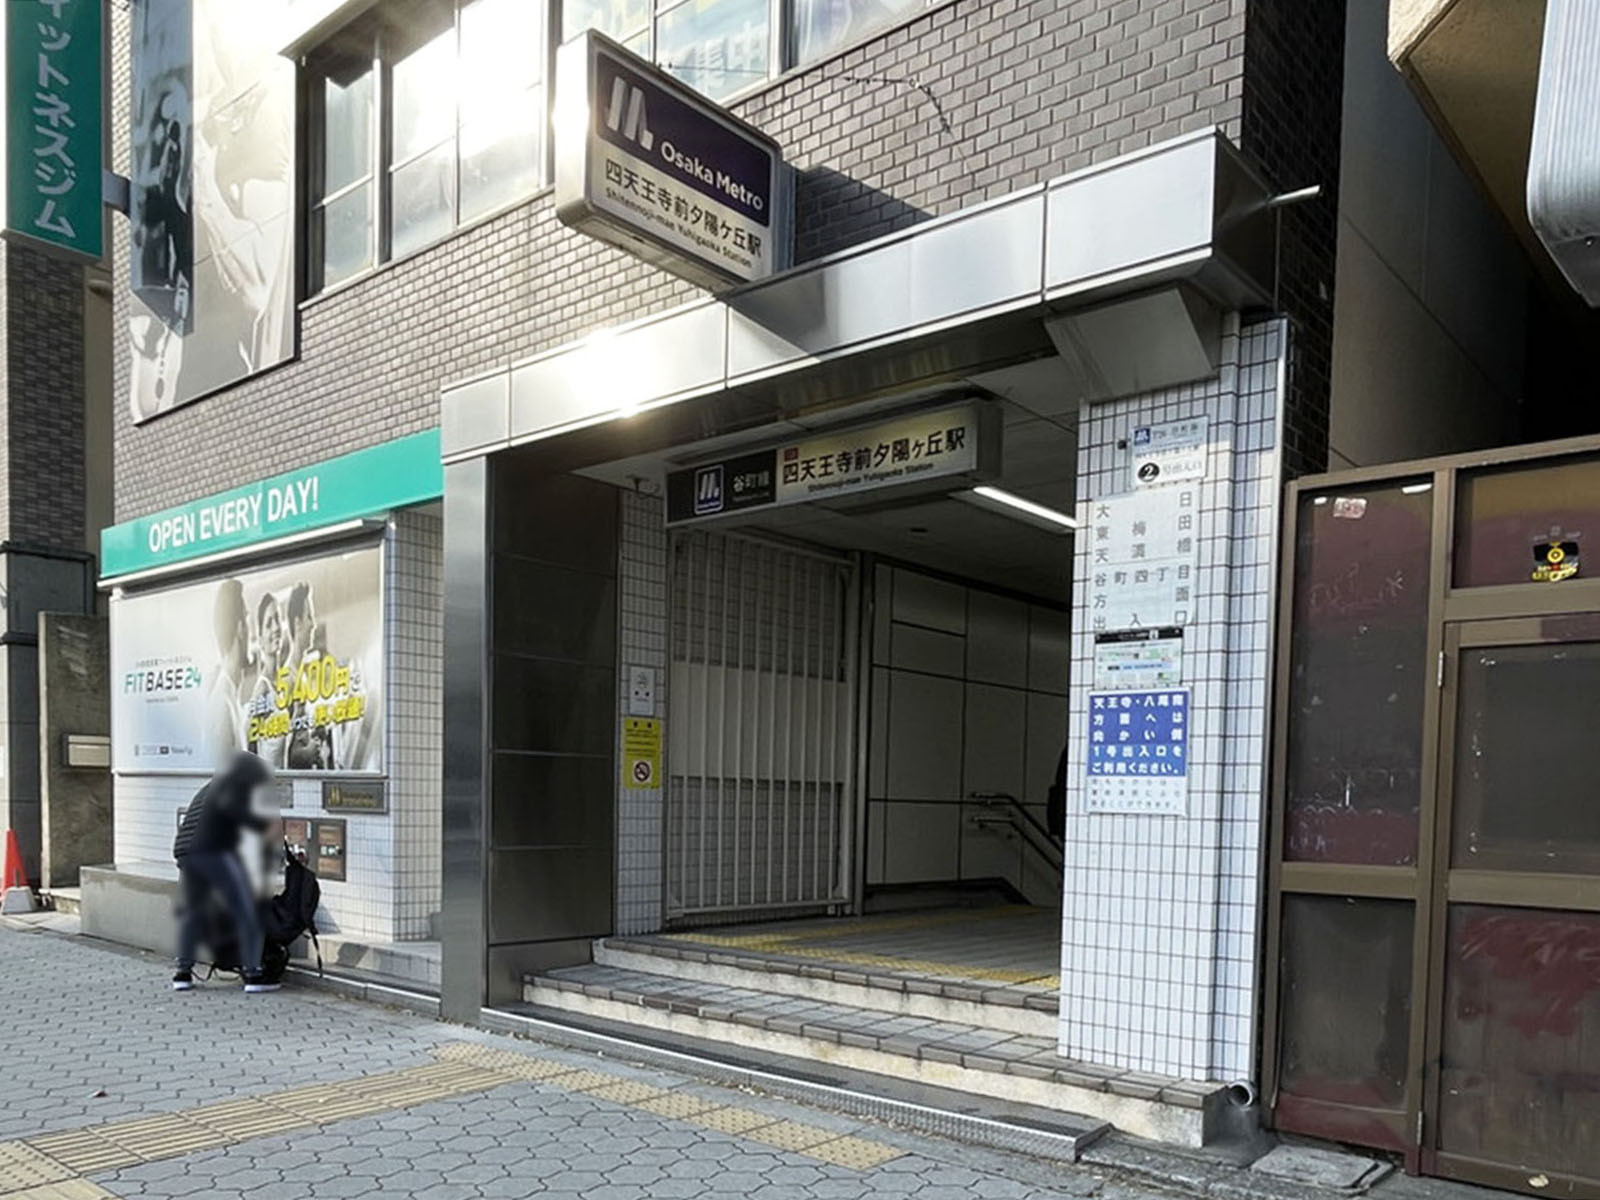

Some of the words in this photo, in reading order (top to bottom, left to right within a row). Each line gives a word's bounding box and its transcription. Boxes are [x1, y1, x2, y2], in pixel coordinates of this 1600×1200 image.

[660, 141, 714, 186] Osaka
[716, 172, 763, 211] Metro
[722, 246, 752, 268] Station
[149, 517, 195, 551] OPEN
[200, 495, 262, 540] EVERY
[267, 476, 319, 523] DAY!
